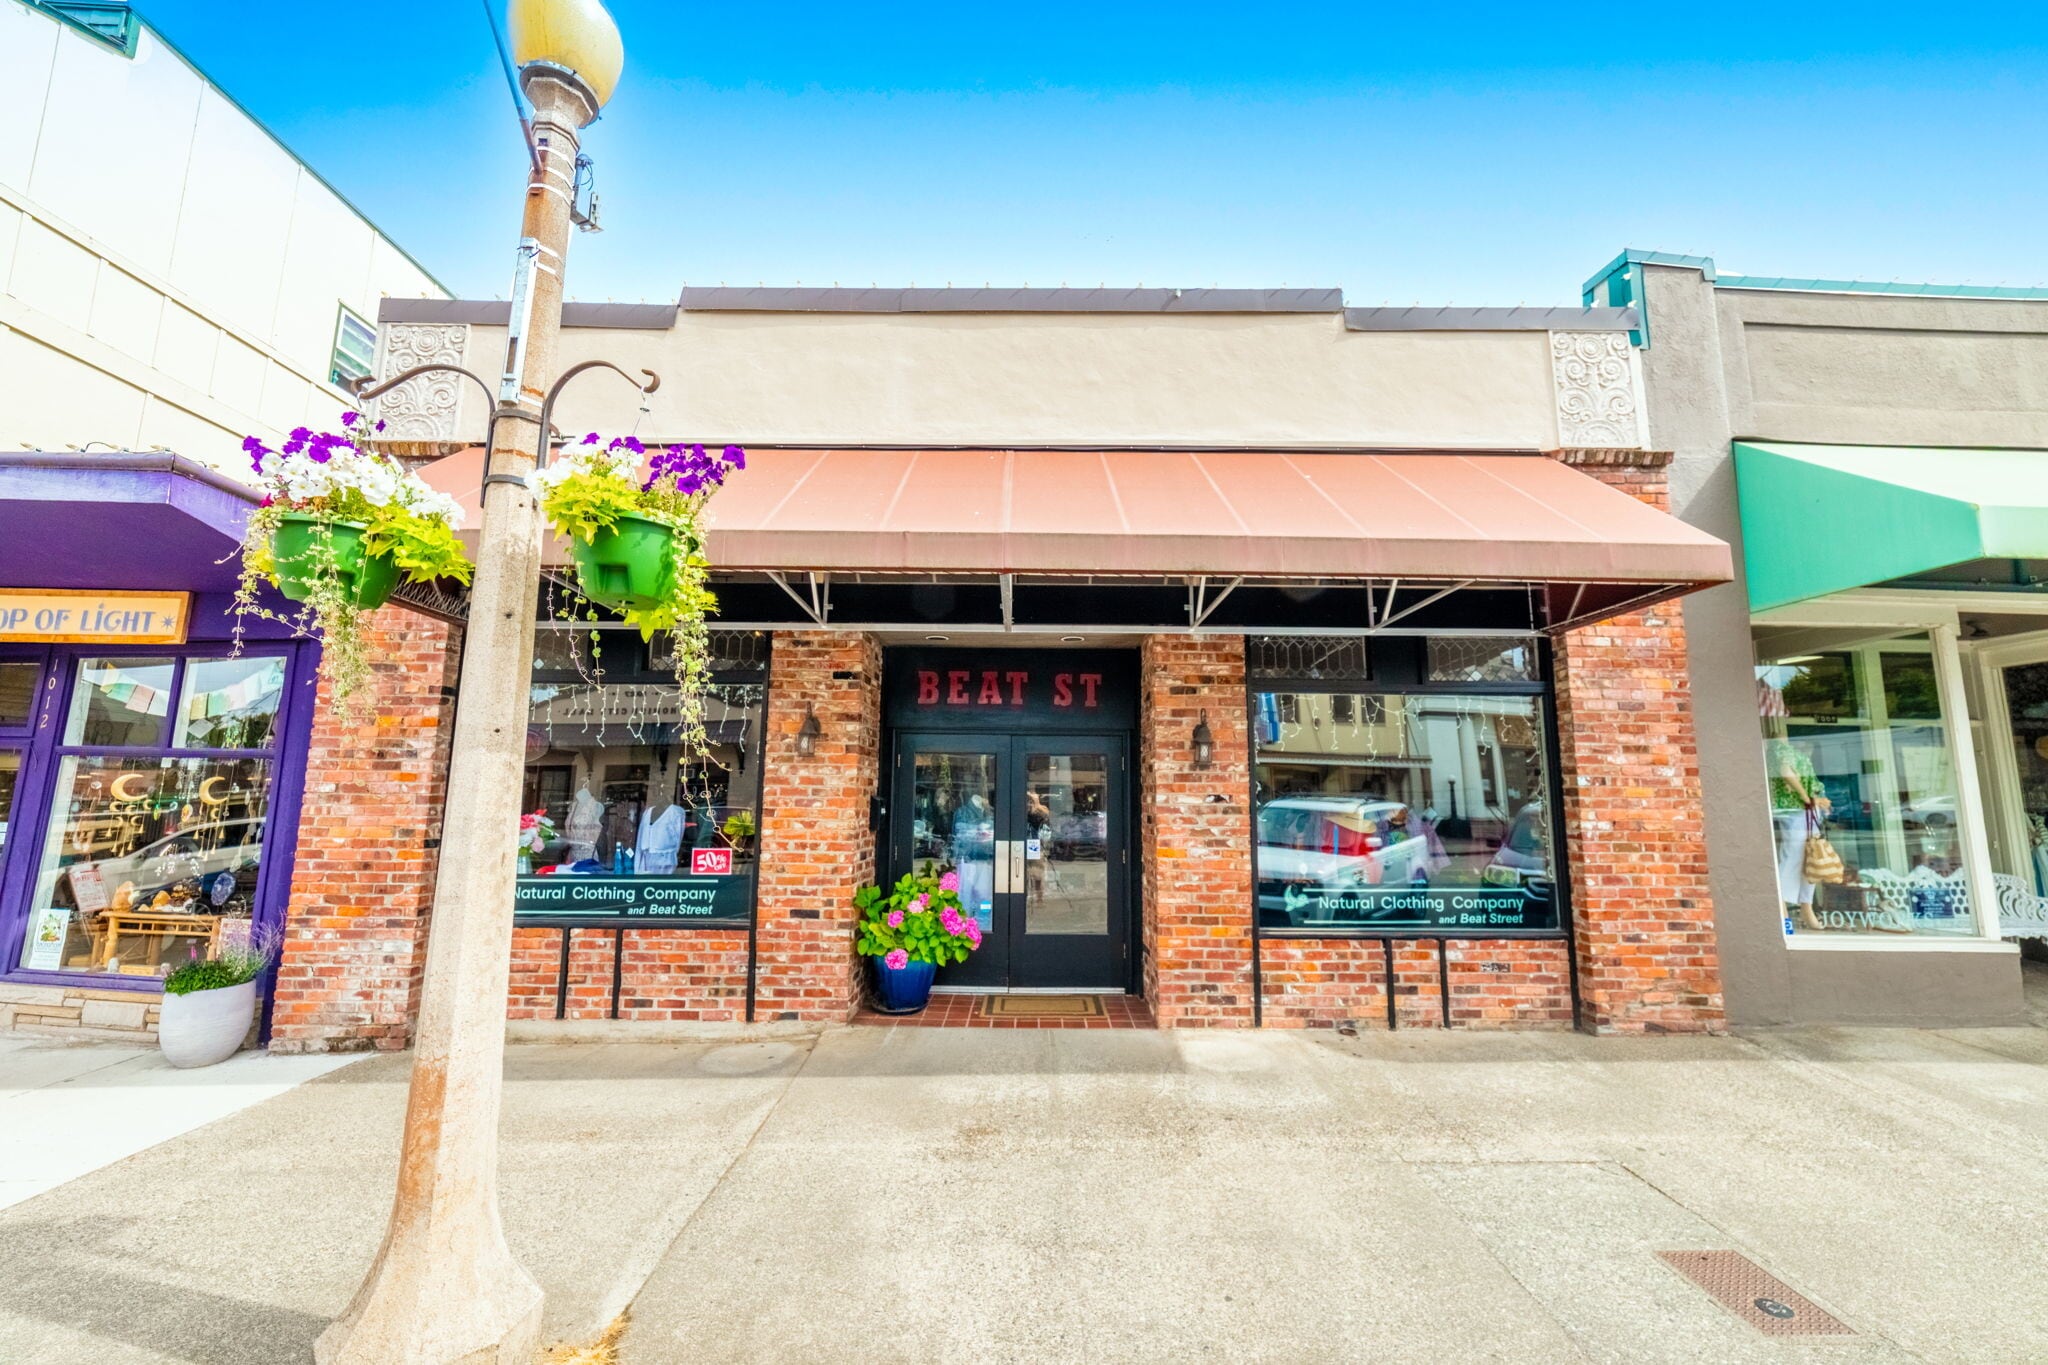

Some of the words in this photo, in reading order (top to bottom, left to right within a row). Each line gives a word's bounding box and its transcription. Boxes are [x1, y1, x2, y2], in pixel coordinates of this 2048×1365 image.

[34, 608, 72, 631] OF
[39, 658, 58, 729] 1012
[917, 670, 1028, 705] BEAT
[1054, 673, 1102, 707] ST
[697, 851, 727, 871] 50%
[572, 886, 636, 902] Clothing
[643, 887, 716, 903] Company
[627, 906, 646, 915] and
[649, 905, 676, 915] Beat
[678, 904, 713, 915] Street
[1319, 896, 1374, 910] Natural
[1381, 896, 1444, 912] Clothing
[1452, 896, 1524, 911] Company
[1438, 914, 1457, 924] and
[1460, 913, 1487, 924] Beat
[1489, 913, 1523, 924] Street
